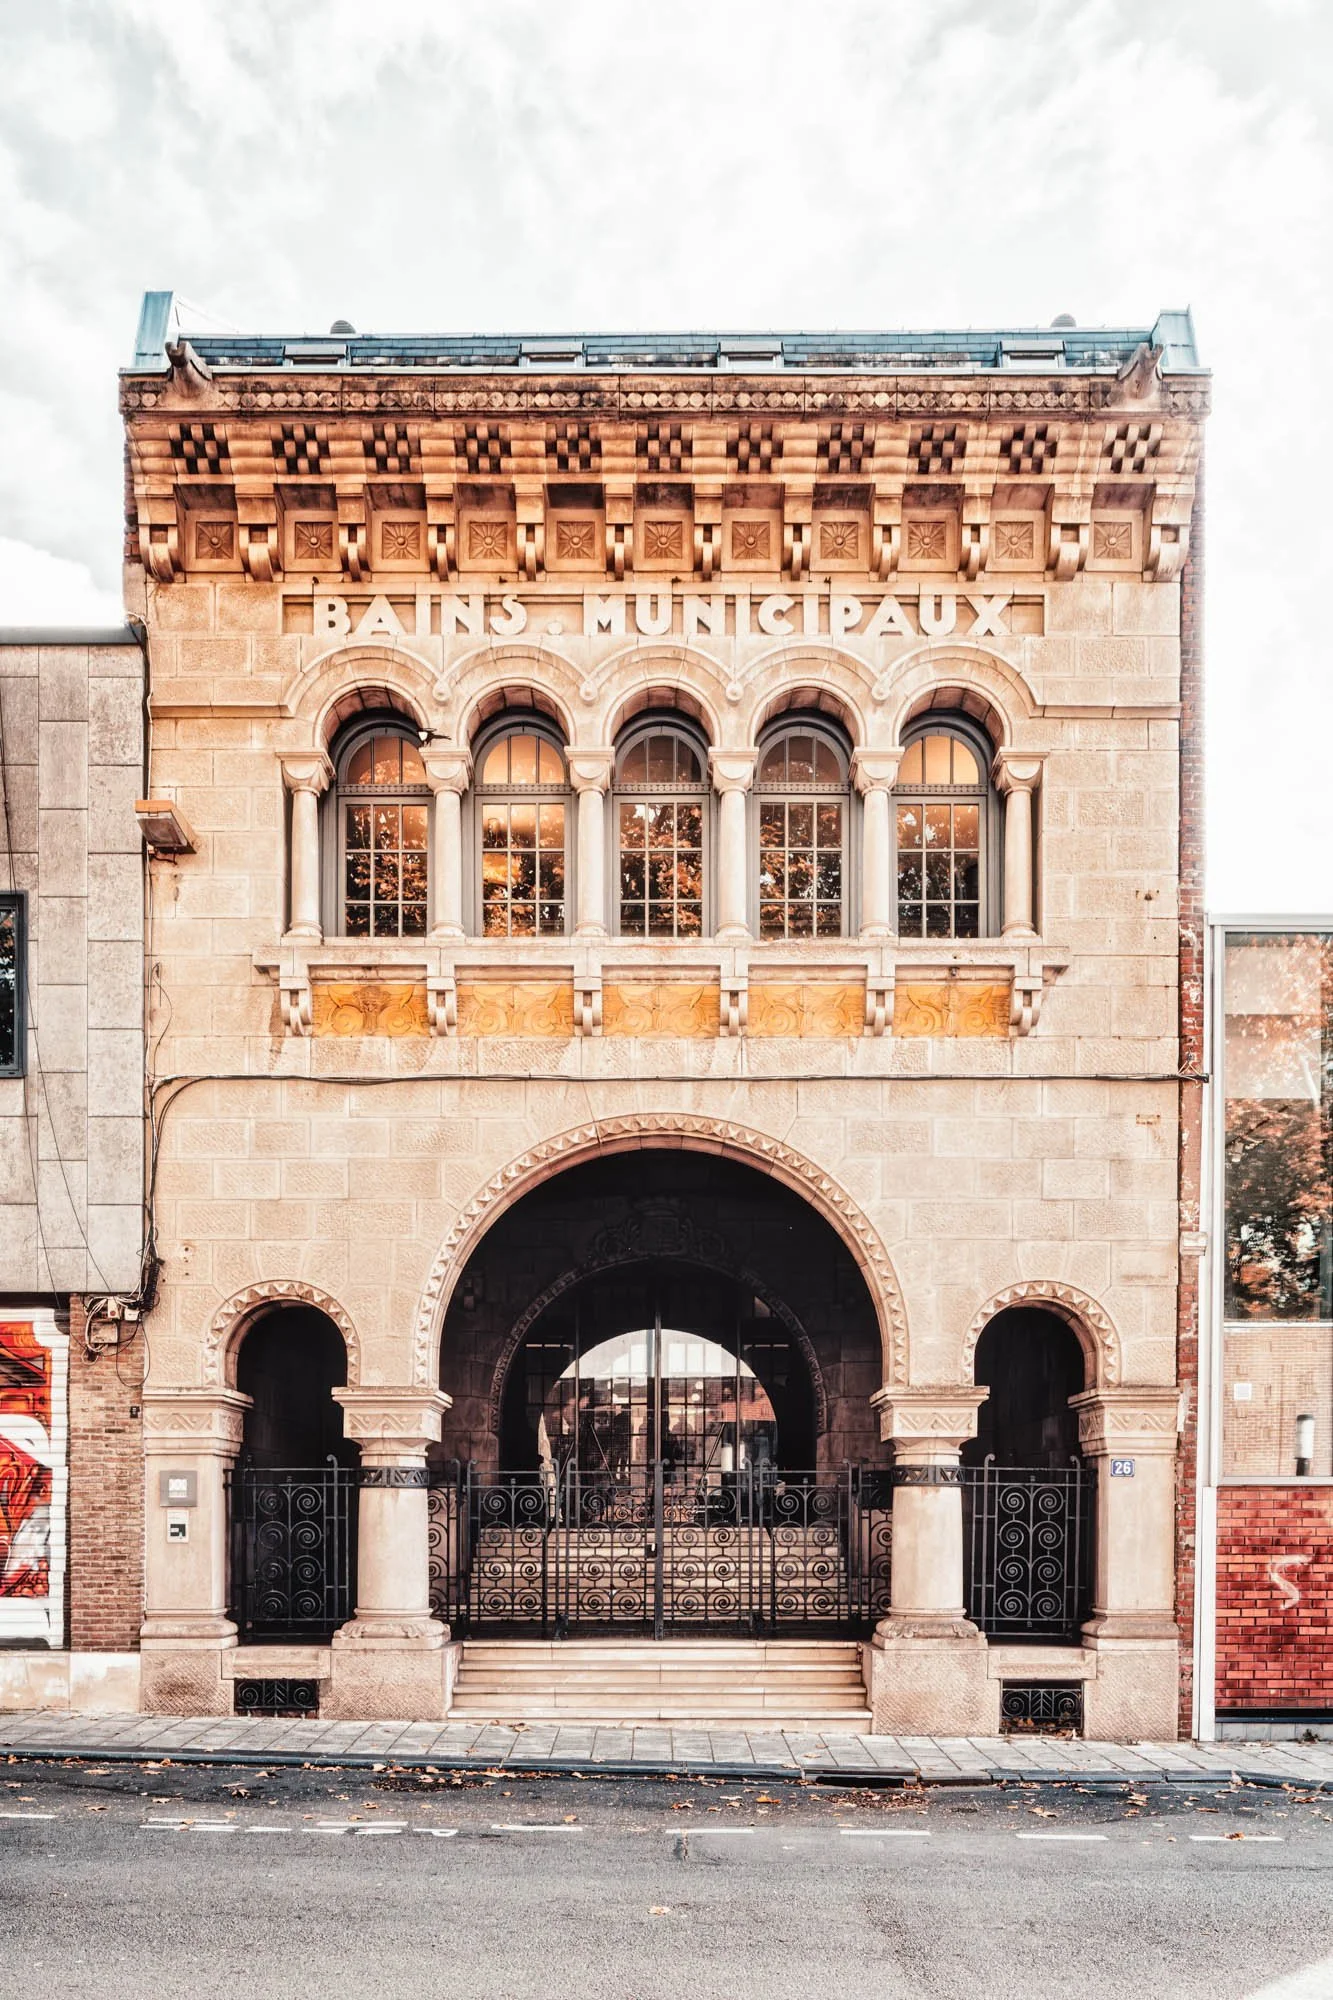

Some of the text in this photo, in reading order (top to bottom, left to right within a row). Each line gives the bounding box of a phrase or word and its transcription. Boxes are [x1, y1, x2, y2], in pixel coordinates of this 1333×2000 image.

[313, 594, 527, 636] BAINS
[583, 594, 1015, 636] MUNICIPAUX
[1115, 1462, 1131, 1474] 26
